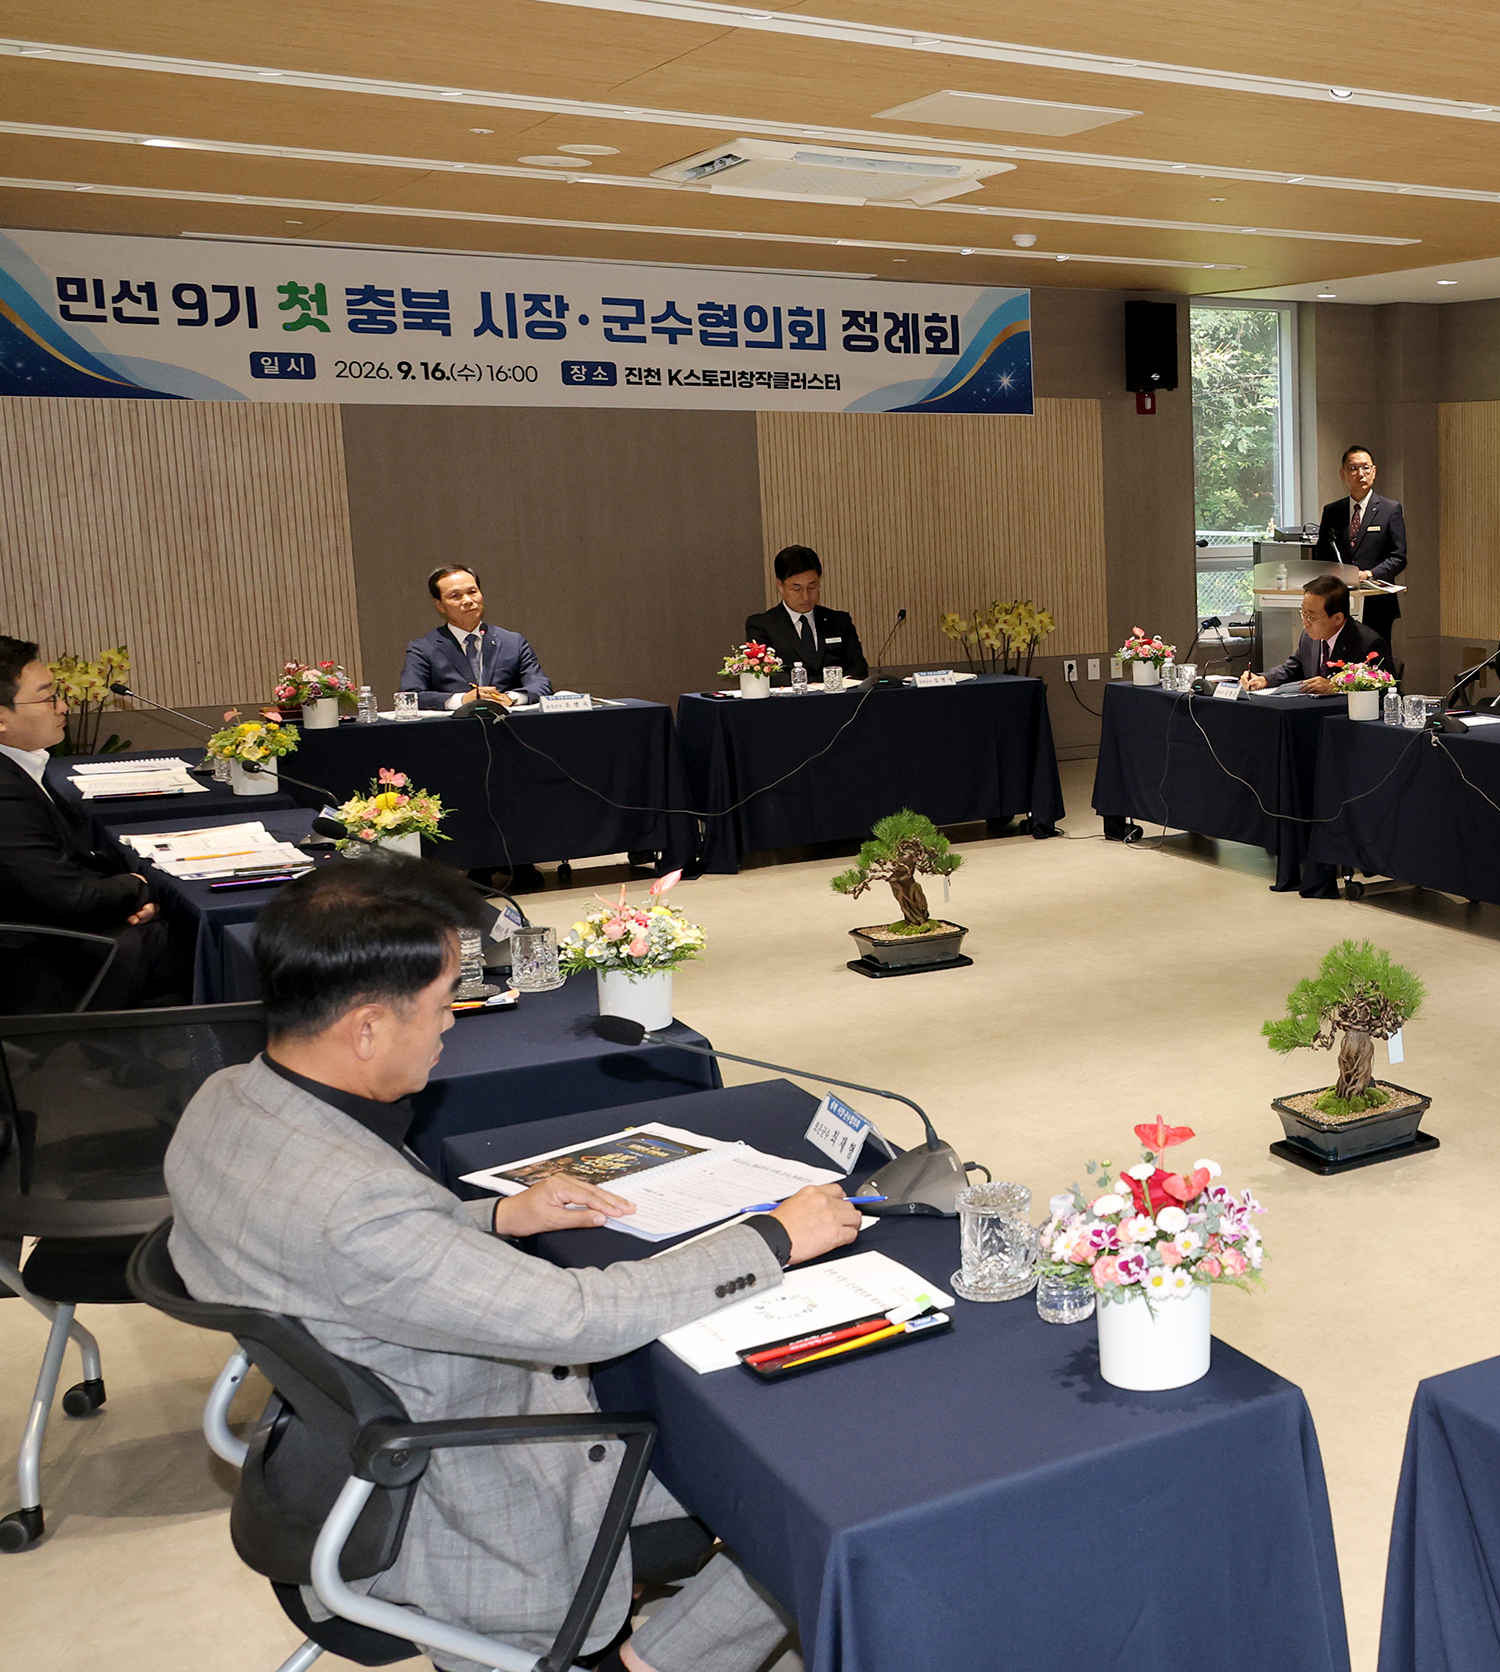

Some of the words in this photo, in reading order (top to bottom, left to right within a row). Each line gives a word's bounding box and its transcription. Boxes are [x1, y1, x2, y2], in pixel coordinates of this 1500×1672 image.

[56, 275, 160, 326] 민선
[172, 283, 260, 329] 9기
[276, 280, 332, 333] 첫
[344, 284, 453, 338] 충북
[473, 290, 828, 352] 시장·군수협의회
[841, 307, 961, 356] 정례회
[624, 366, 663, 386] 진천
[667, 368, 842, 391] K스토리창작클러스터
